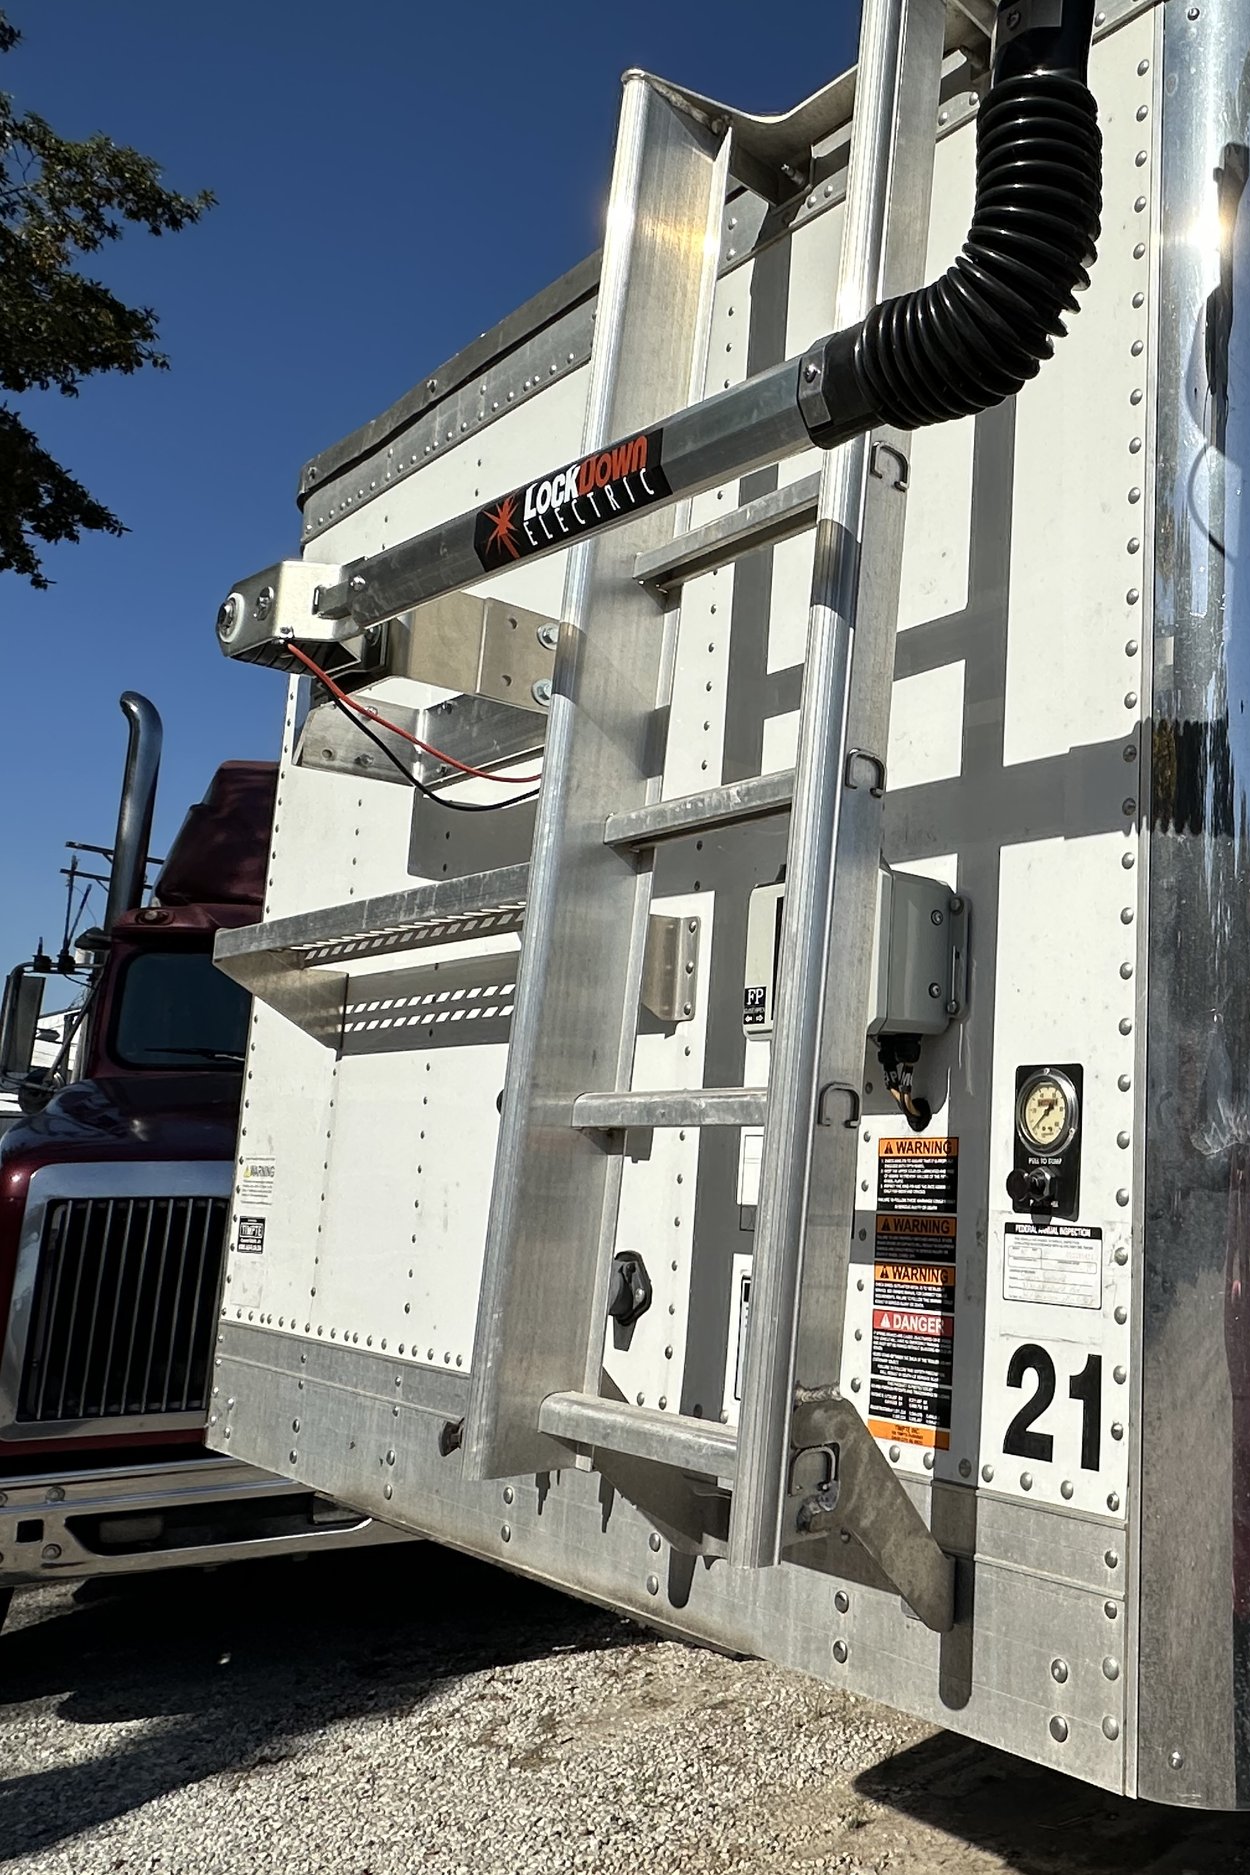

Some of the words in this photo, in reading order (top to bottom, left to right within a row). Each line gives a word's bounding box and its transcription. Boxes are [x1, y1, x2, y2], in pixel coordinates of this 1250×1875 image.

[523, 435, 648, 521] LOCKDOWN
[523, 468, 655, 546] ELECTRIC
[746, 988, 764, 1005] FP
[896, 1141, 952, 1155] WARNING
[250, 1165, 275, 1178] WARNING
[894, 1218, 950, 1234] WARNING
[1015, 1224, 1037, 1234] FEDERAL
[1059, 1227, 1091, 1237] INSPECTION
[892, 1266, 948, 1284] WARNING
[893, 1314, 944, 1334] DANGER
[1003, 1343, 1102, 1472] 21
